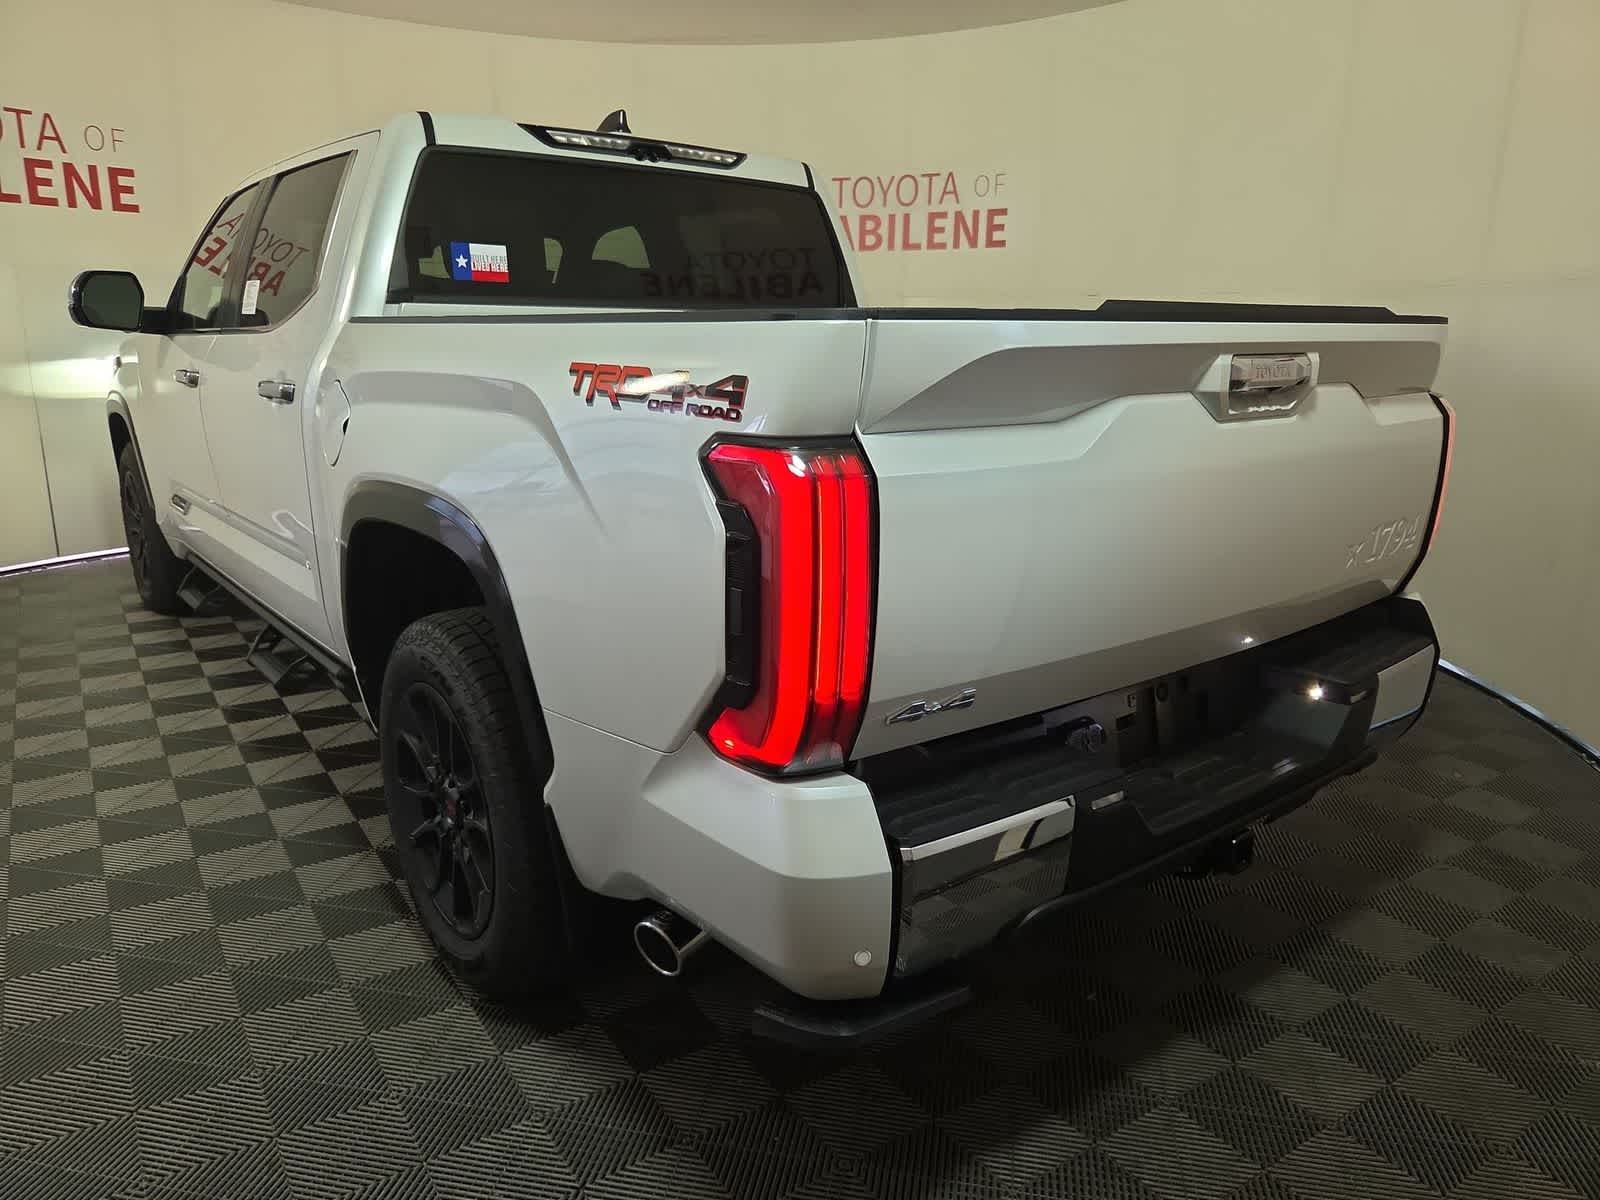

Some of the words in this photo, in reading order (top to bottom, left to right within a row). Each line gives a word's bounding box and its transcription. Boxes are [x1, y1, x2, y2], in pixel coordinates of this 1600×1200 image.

[0, 107, 67, 154] TA
[83, 124, 125, 152] OF
[832, 171, 960, 209] TOYOTA
[974, 172, 1007, 199] OF
[569, 362, 655, 411] TRD
[647, 399, 685, 415] OFF
[685, 402, 743, 423] ROAD
